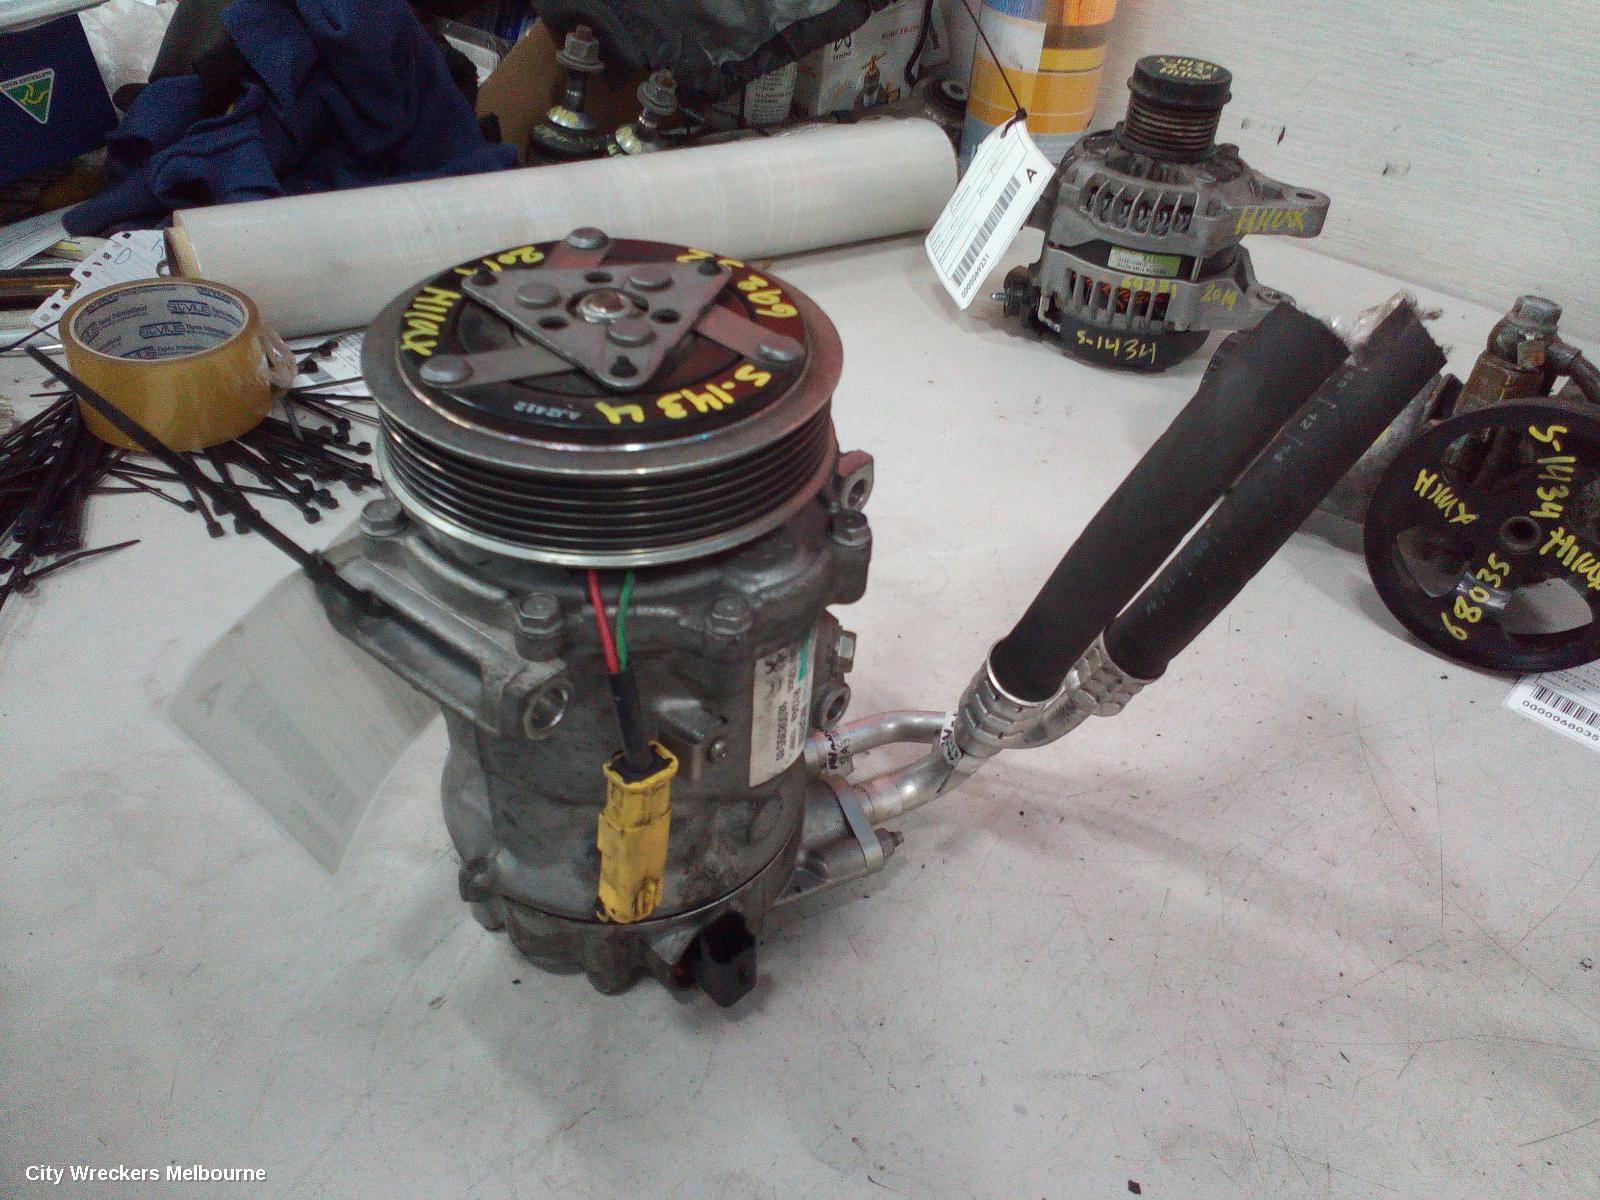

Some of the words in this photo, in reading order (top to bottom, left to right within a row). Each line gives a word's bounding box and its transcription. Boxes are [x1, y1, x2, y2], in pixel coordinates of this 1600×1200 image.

[1026, 168, 1038, 184] A
[1076, 329, 1157, 366] S-1434
[1528, 425, 1577, 519] S-1434
[1440, 552, 1511, 641] 68035
